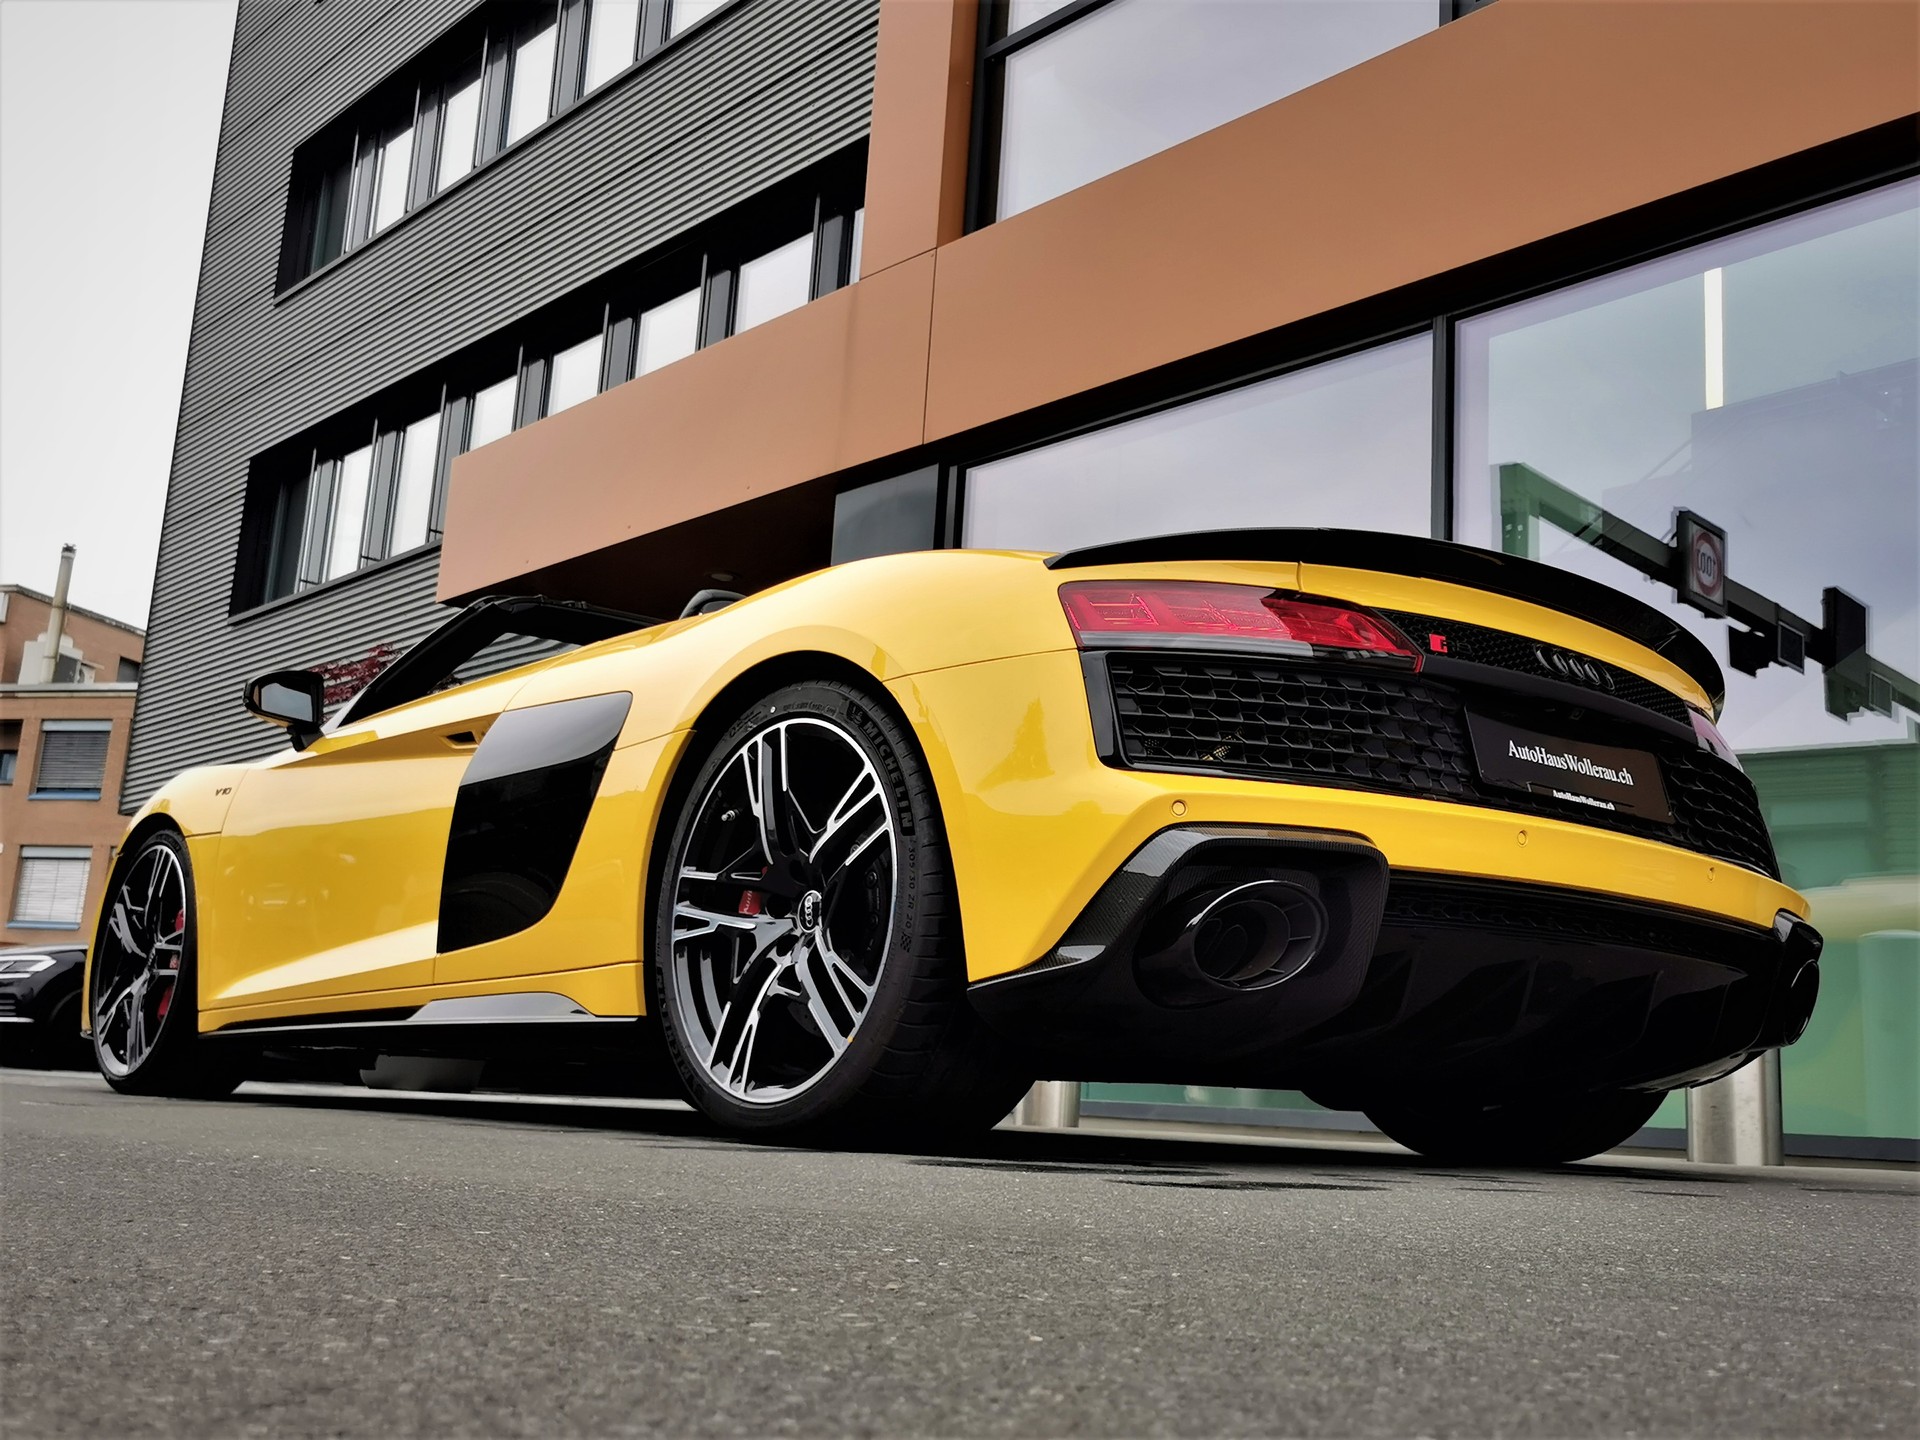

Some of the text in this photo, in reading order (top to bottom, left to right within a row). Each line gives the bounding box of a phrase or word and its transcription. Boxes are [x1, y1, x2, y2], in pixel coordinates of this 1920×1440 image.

[862, 720, 914, 828] MICHELIN
[1508, 740, 1634, 786] AutoHausWollerau.ch
[215, 787, 233, 796] V10
[1552, 790, 1616, 811] AutoHausWollerau.ch
